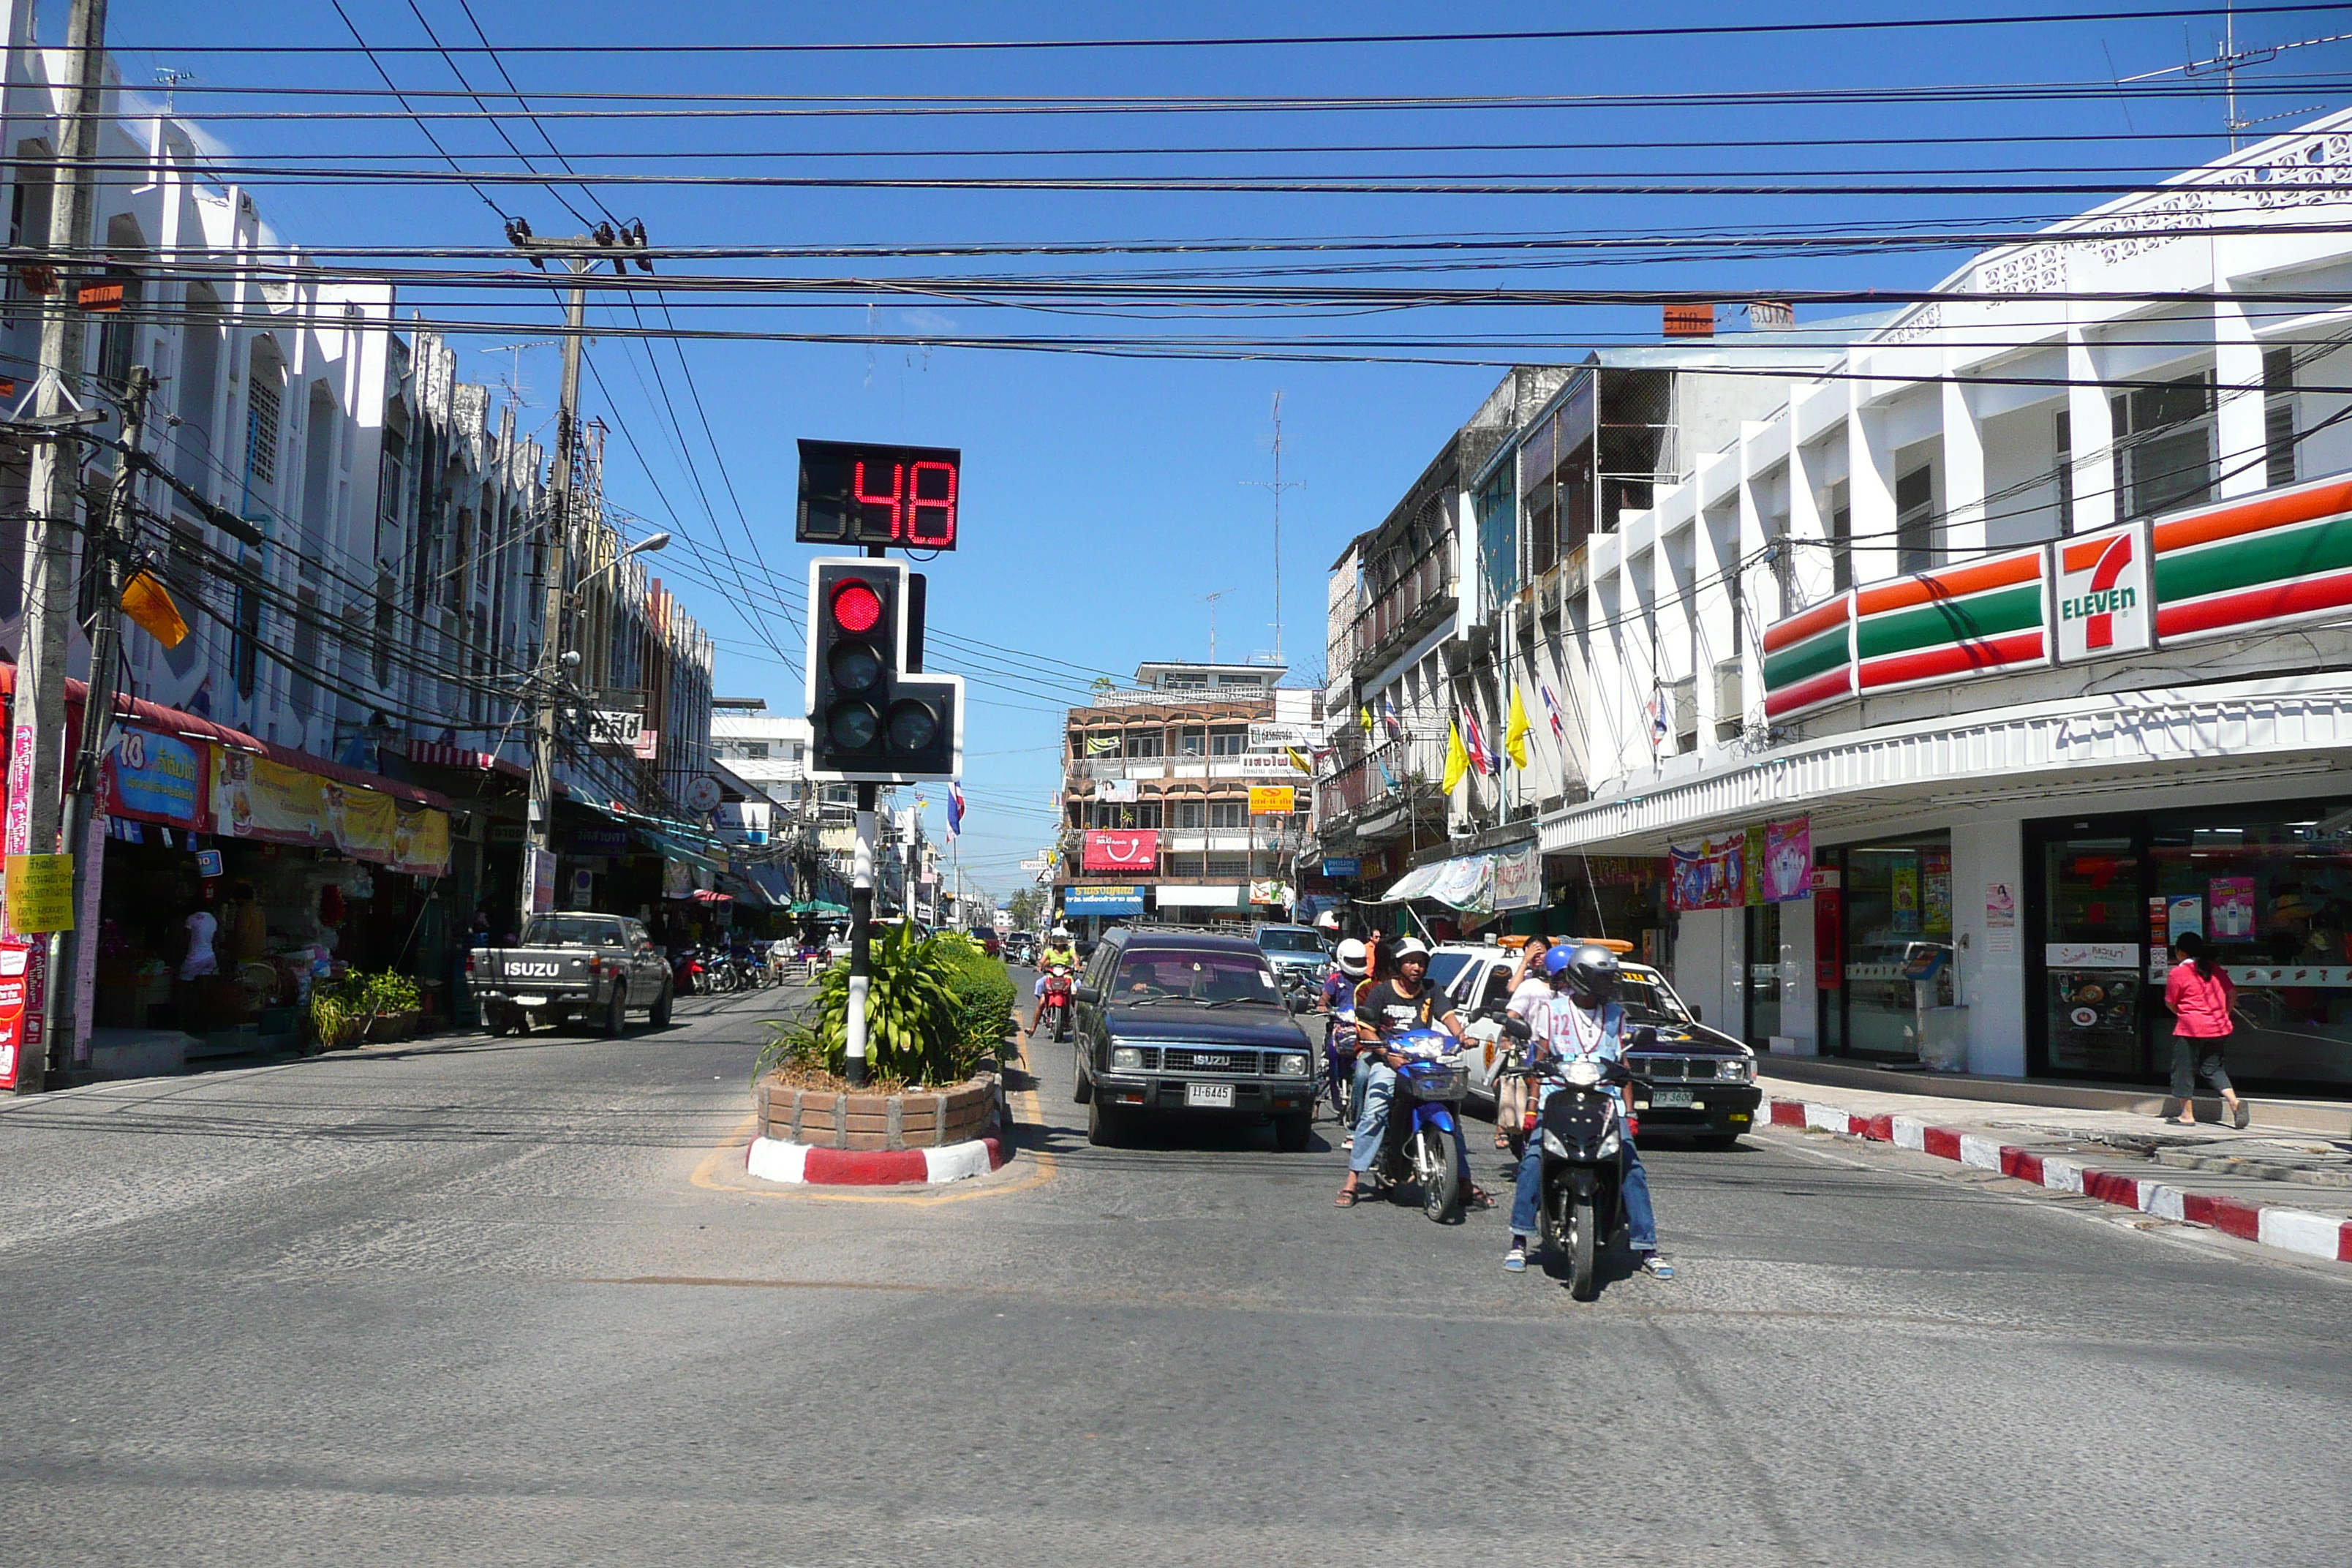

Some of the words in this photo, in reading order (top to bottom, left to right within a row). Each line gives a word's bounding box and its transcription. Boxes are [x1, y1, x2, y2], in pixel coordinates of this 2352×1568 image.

[1750, 305, 1773, 323] 5.0
[854, 461, 957, 546] 48
[2062, 532, 2133, 652] 7
[505, 962, 559, 977] ISUZU
[1553, 1014, 1570, 1036] 12
[1194, 1055, 1231, 1066] ISUZU
